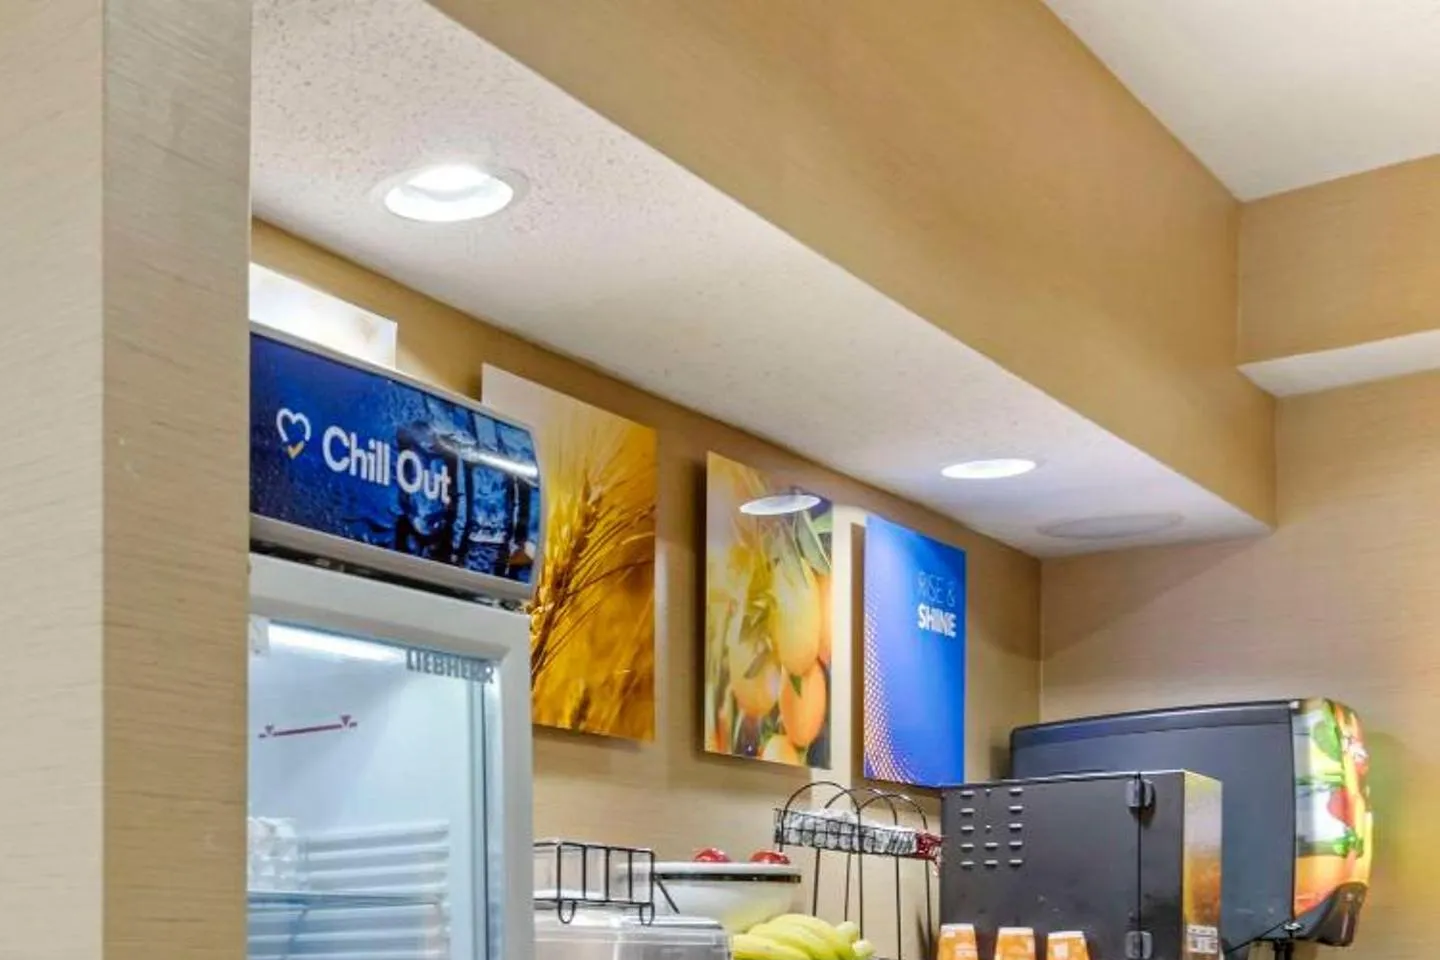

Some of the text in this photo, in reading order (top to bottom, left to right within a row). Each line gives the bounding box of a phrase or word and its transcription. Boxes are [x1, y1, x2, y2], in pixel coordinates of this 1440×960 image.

[322, 425, 452, 505] Chill Out
[917, 569, 944, 604] RISE
[917, 602, 957, 638] SHINE
[406, 647, 494, 684] LIEBHERR
